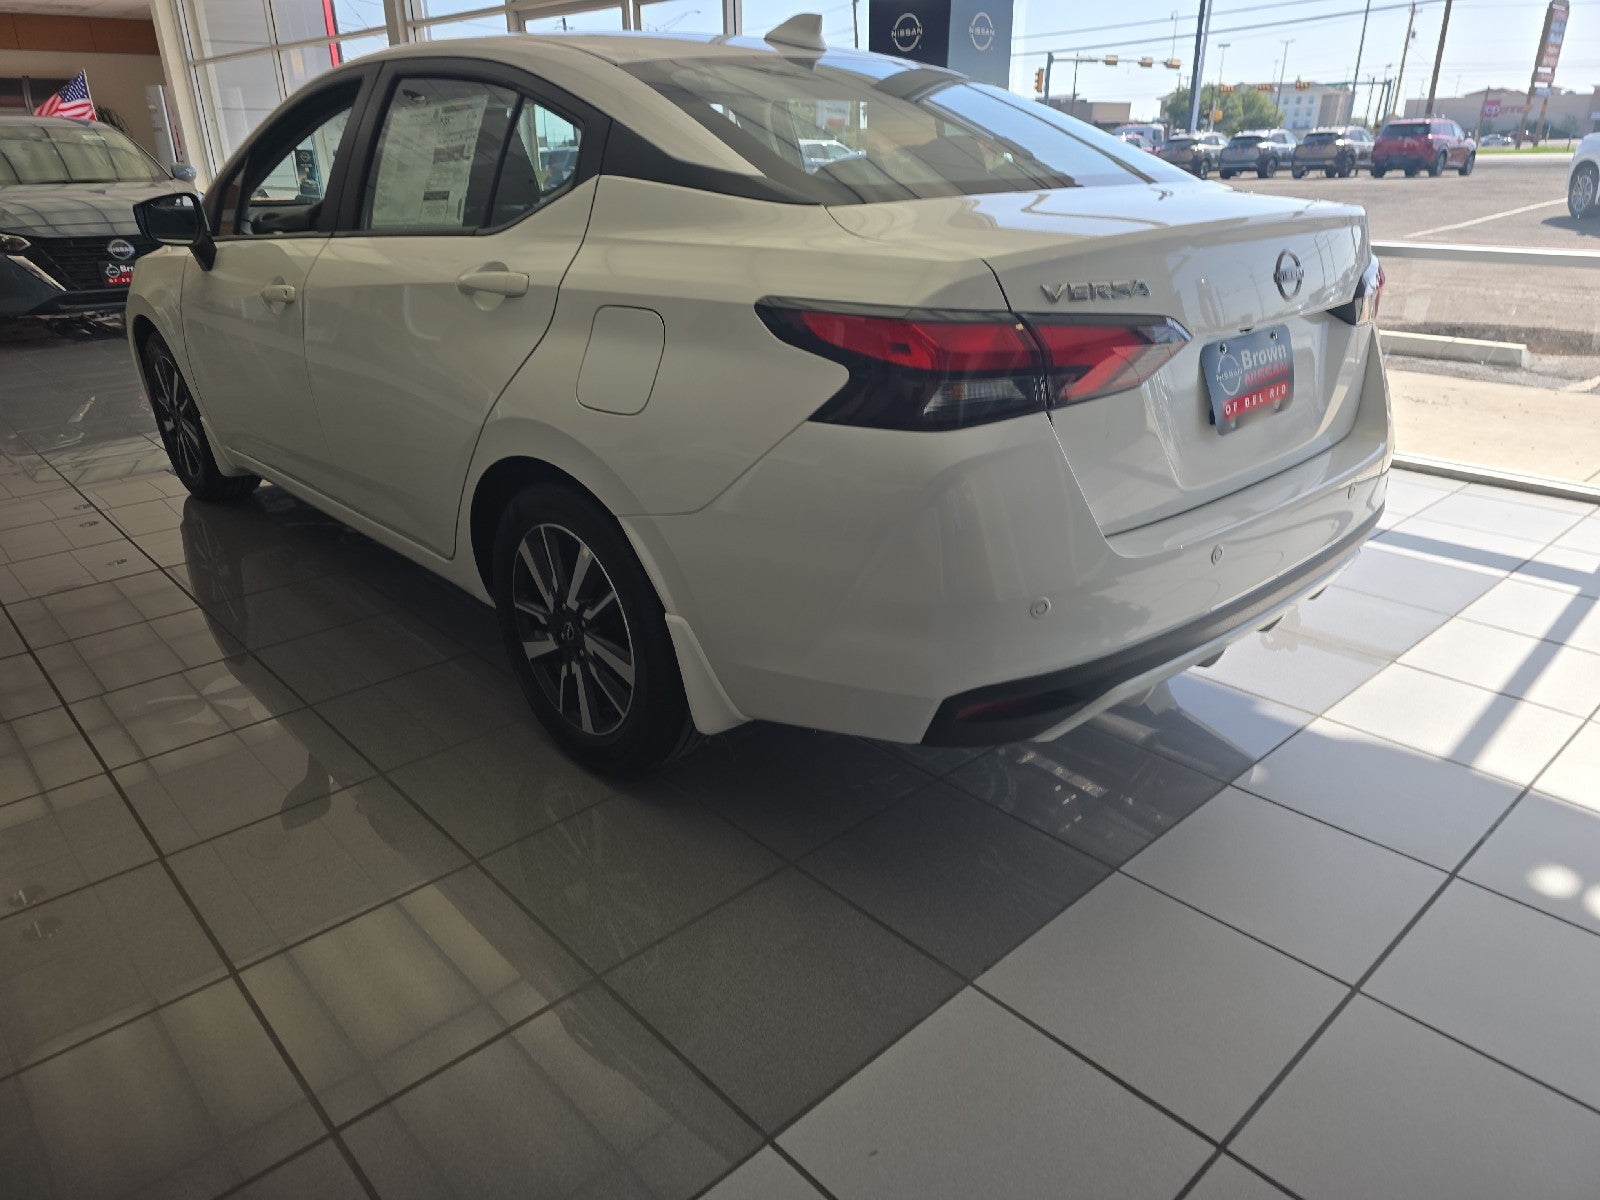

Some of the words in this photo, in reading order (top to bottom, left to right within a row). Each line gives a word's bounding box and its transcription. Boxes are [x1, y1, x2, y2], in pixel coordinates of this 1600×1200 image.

[891, 26, 923, 39] NISSAN
[968, 25, 995, 37] NISSAN
[1040, 279, 1151, 304] VERSA
[1241, 344, 1287, 370] Brown
[1244, 361, 1289, 387] NISSAN
[1225, 401, 1238, 416] OF
[1244, 392, 1264, 408] DEL
[1269, 384, 1287, 399] RIO
